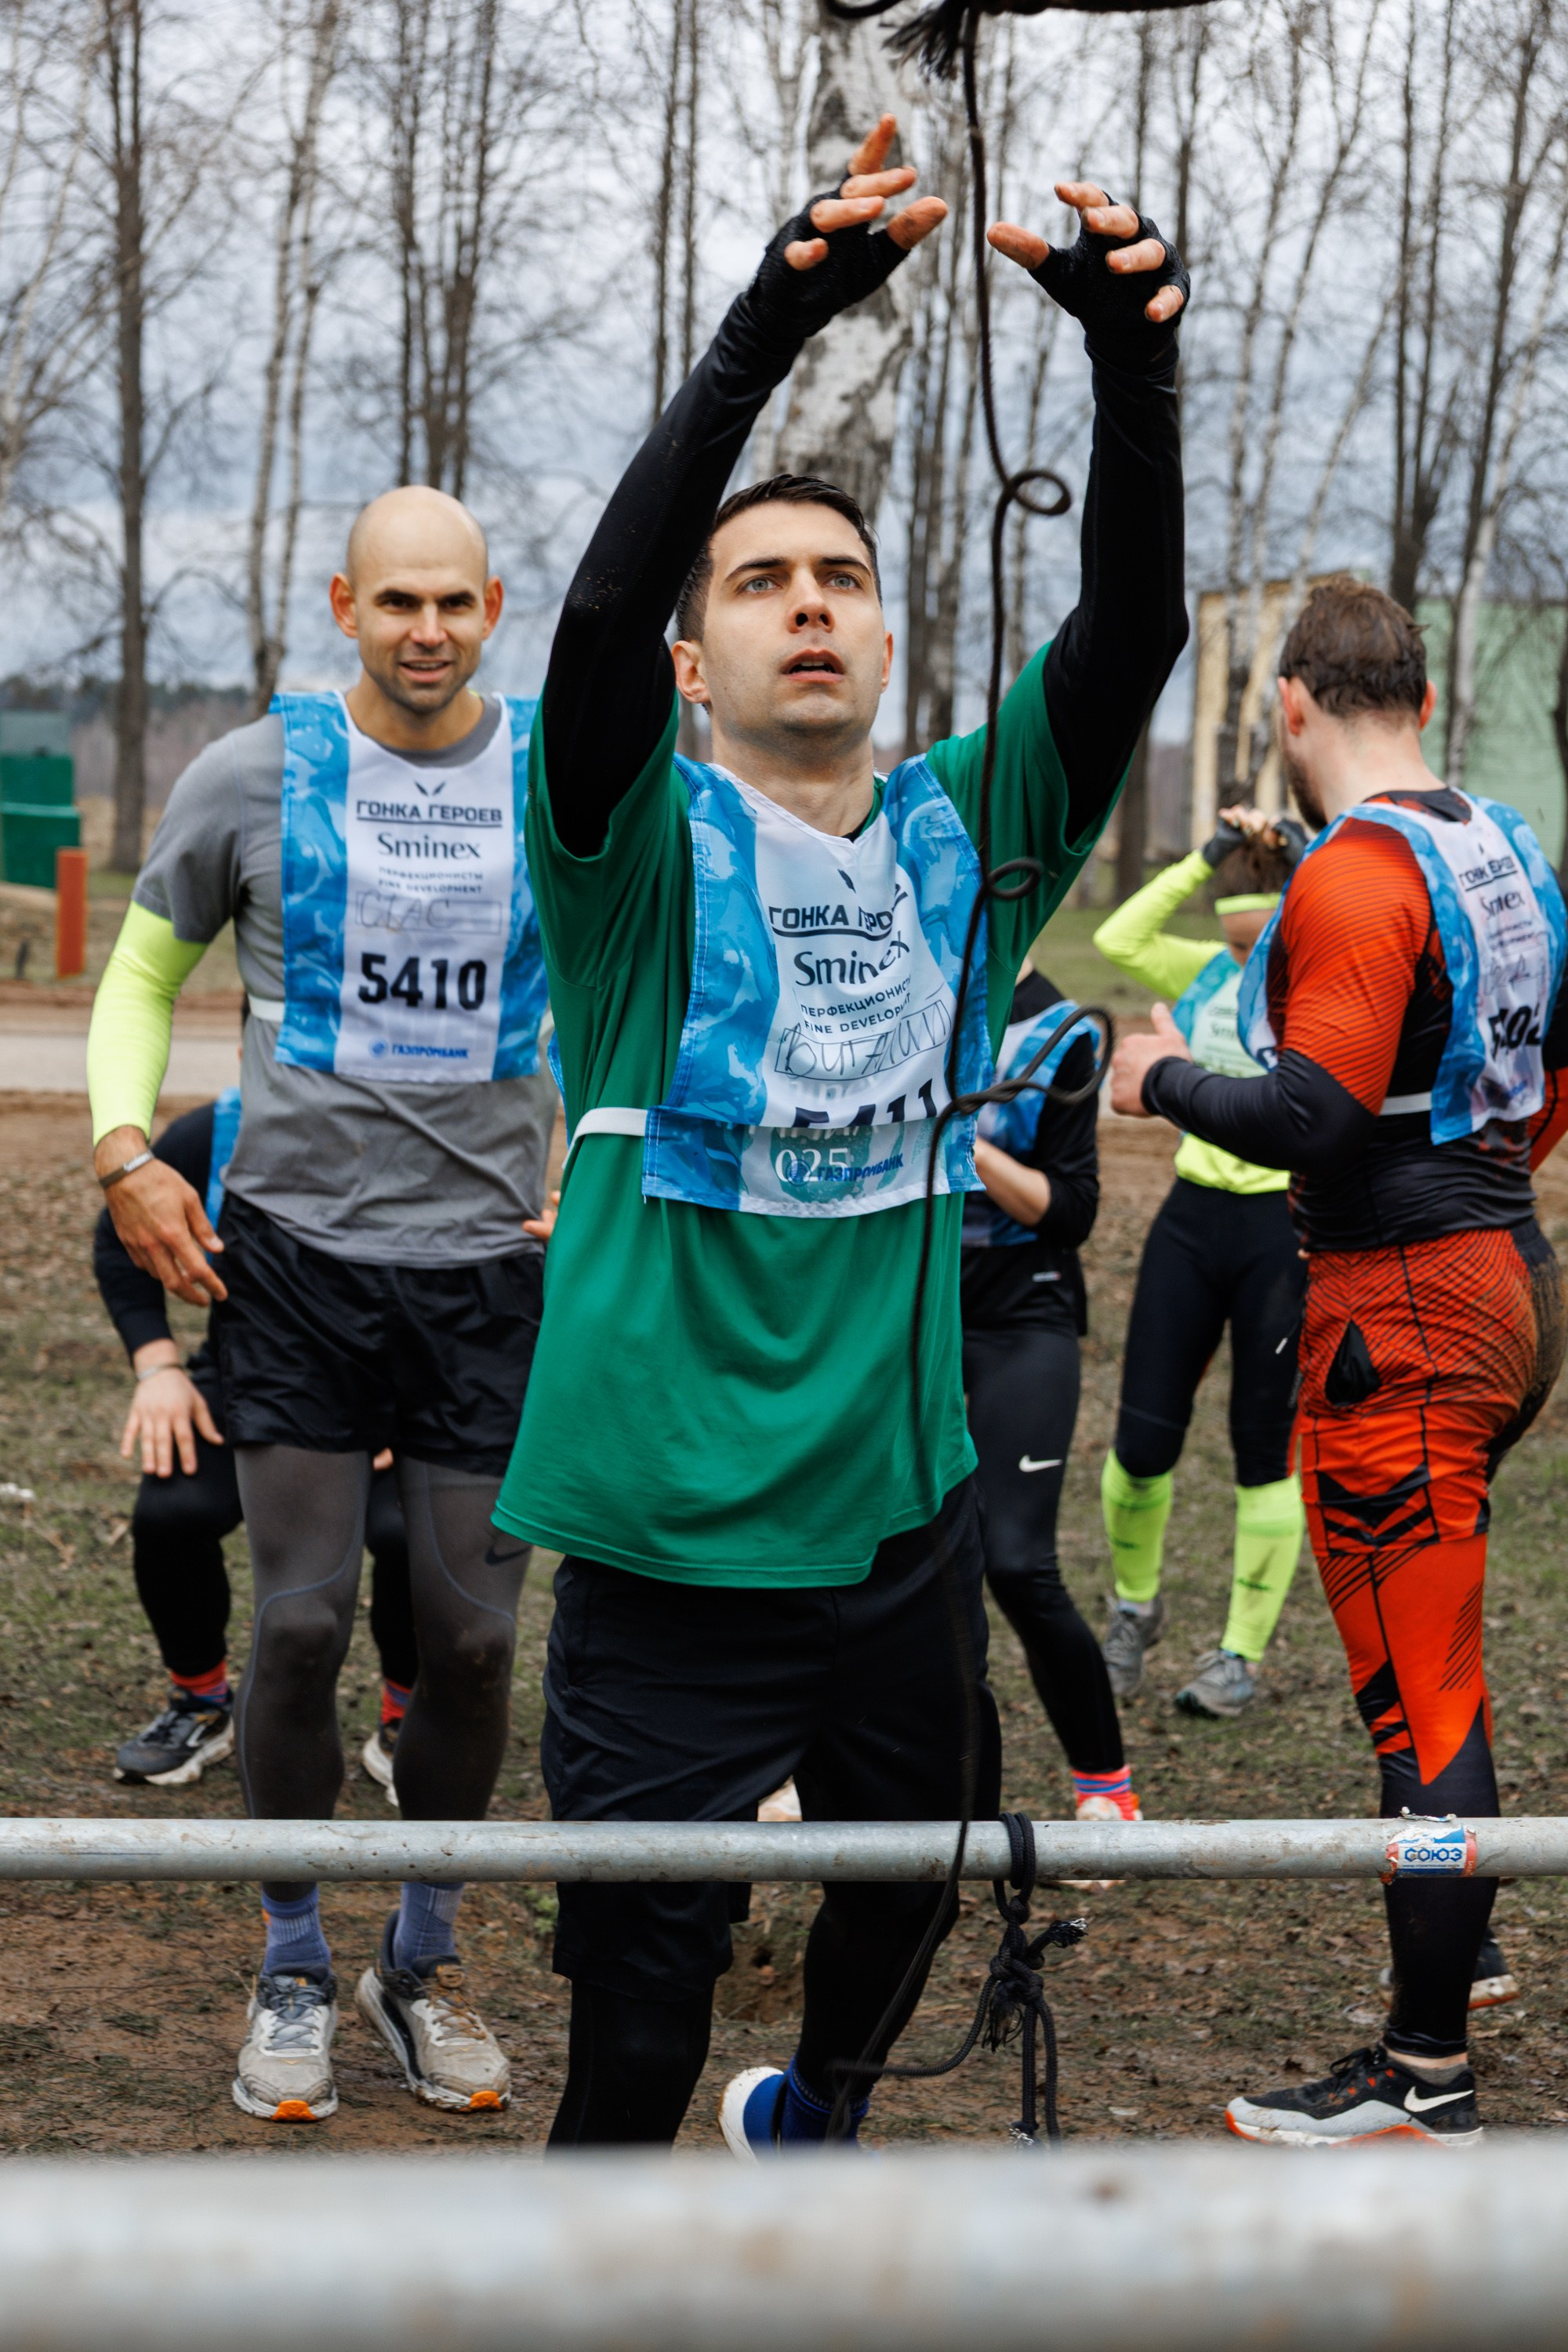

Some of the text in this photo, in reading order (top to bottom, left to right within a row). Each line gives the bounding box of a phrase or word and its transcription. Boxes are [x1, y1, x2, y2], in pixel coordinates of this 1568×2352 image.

[357, 800, 503, 822] ГОНКА ГЕРОЕВ
[378, 832, 481, 859] Sminex
[768, 904, 850, 929] ГОНКА
[793, 931, 910, 986] Sminex
[358, 952, 487, 1011] 5410
[804, 1019, 833, 1034] FINE
[818, 1153, 904, 1182] ГАЗПРОМБАНК
[1404, 1847, 1463, 1863] СОЮЗ
